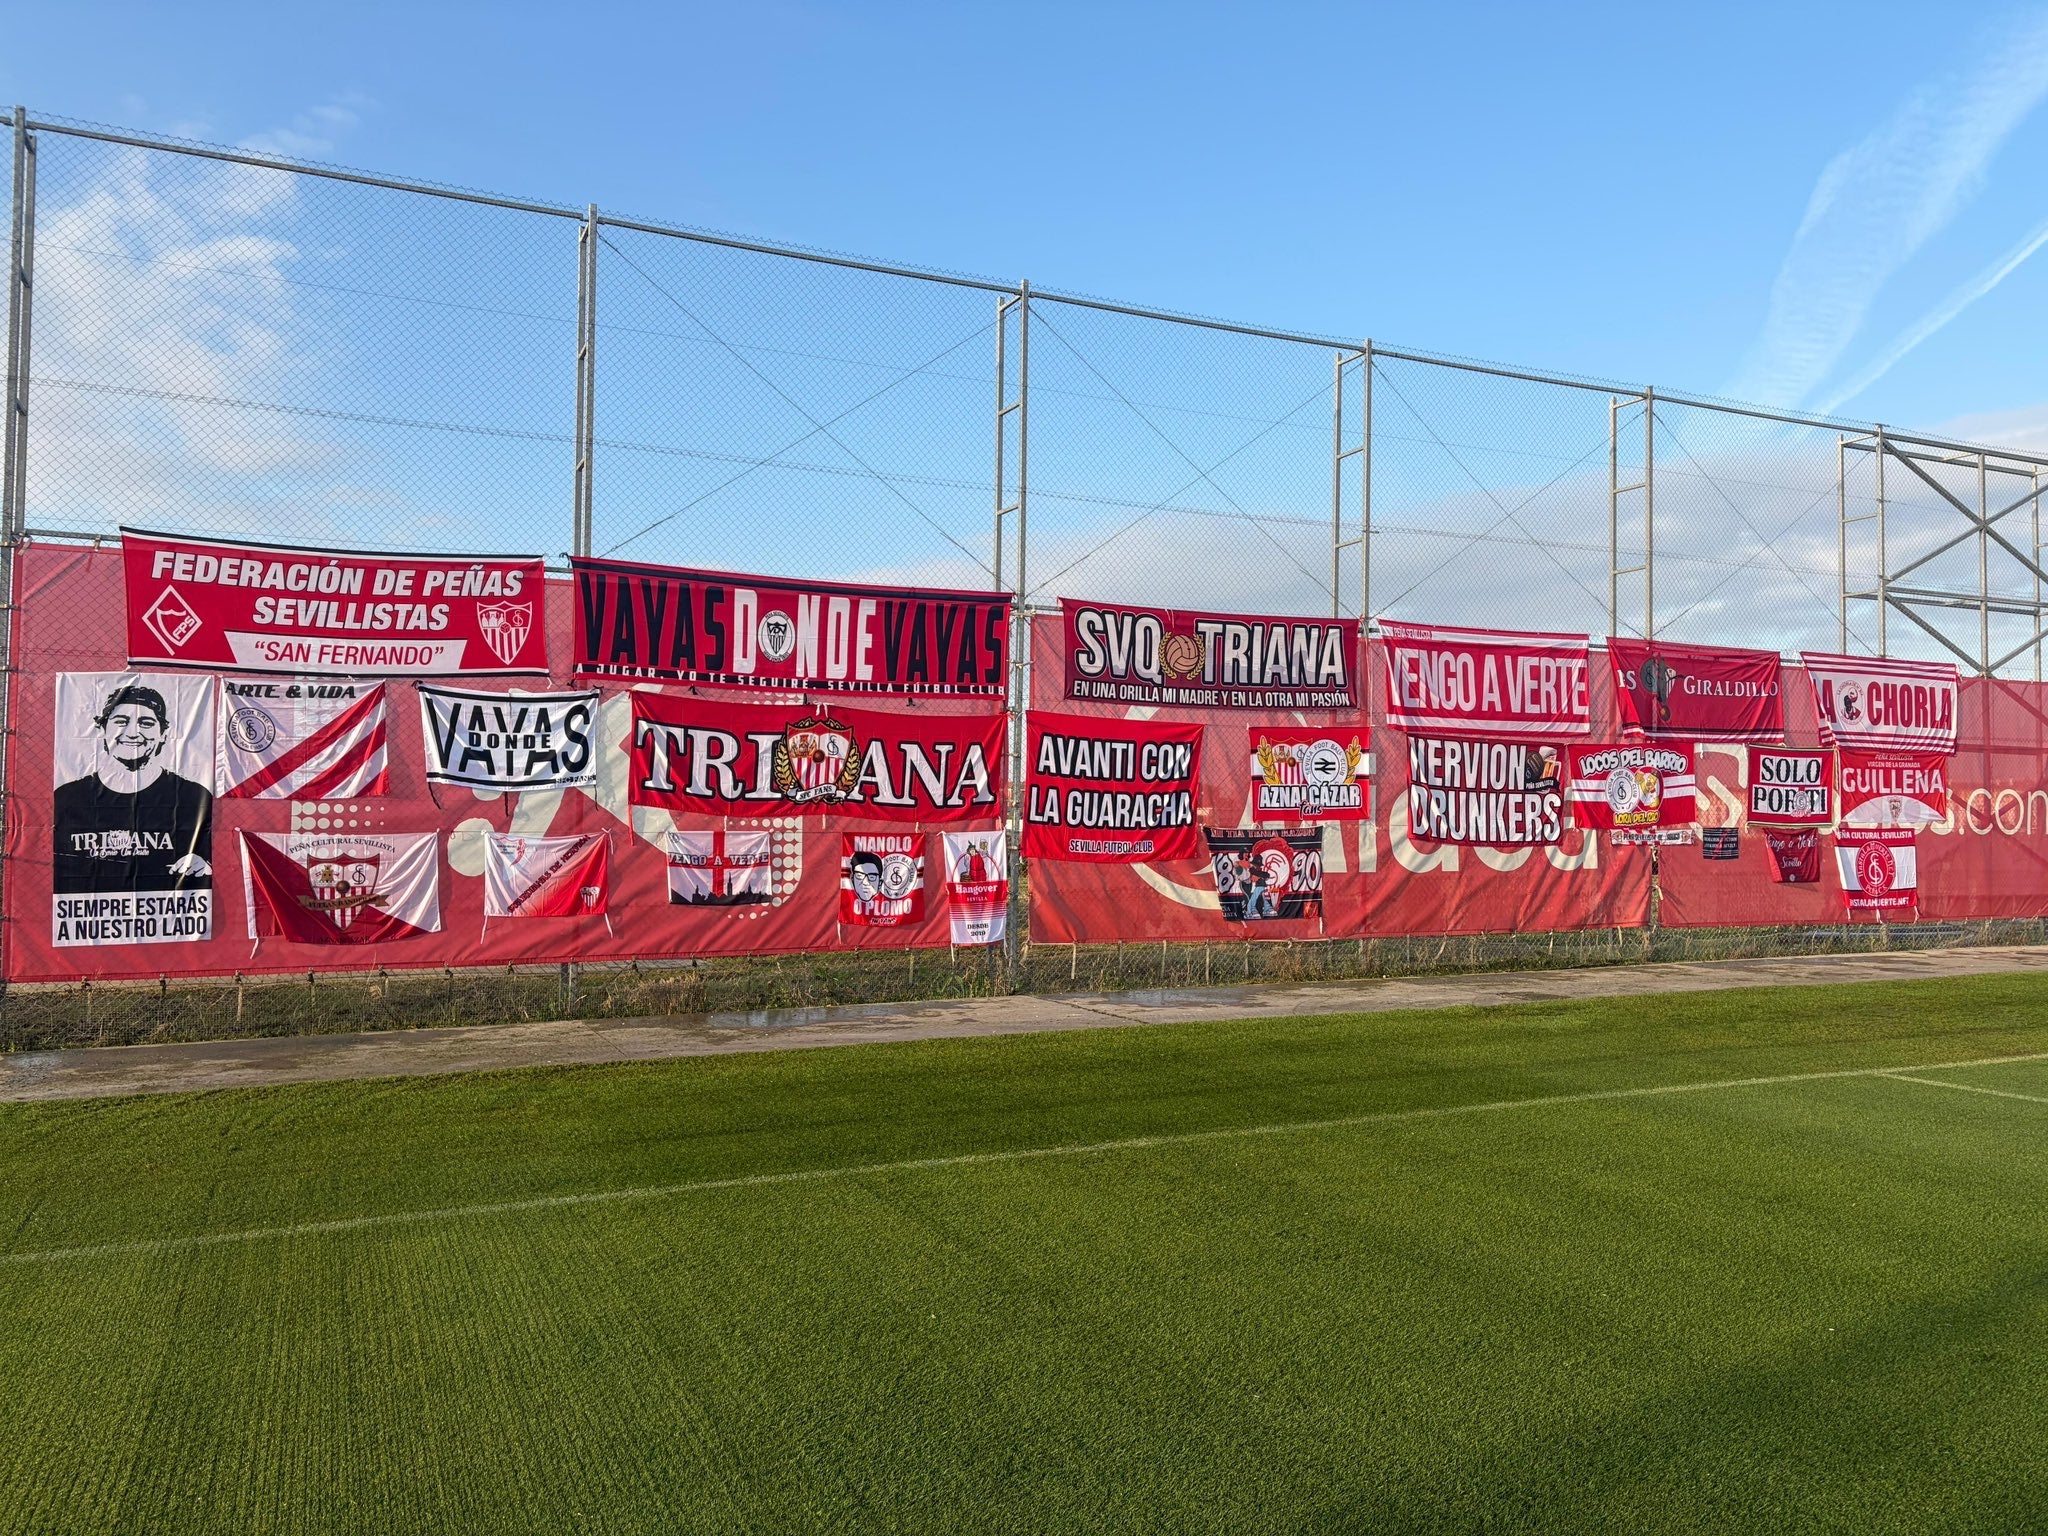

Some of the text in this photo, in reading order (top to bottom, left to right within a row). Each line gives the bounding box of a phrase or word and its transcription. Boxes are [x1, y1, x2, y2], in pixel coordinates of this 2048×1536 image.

[151, 550, 525, 597] FEDERACIÓN DE PEÑAS
[172, 615, 196, 640] FPS
[252, 596, 450, 632] SEVILLISTAS
[578, 571, 725, 672] VAYAS
[883, 599, 1004, 684] VAYAS
[1076, 608, 1348, 688] SVQ TRIANA
[225, 681, 357, 699] ARTE & VIDA
[576, 663, 584, 674] A
[677, 669, 697, 681] YO
[709, 672, 726, 684] TE
[827, 680, 894, 693] SEVILLA
[903, 681, 960, 694] FÚTBOL
[969, 684, 1005, 696] CLUB
[1384, 645, 1590, 715] VENGO A VERTE
[1073, 680, 1350, 708] EN UNA ORILLA MI MADRE Y EN LA OTRA MI PASIÓN
[1866, 680, 1952, 731] CHORLA
[425, 697, 592, 777] VAYAS
[468, 731, 551, 750] DONDE
[633, 718, 998, 809] TRIANA
[1037, 733, 1194, 782] AVANTI CON
[1305, 751, 1313, 775] SEVILLA
[1314, 742, 1328, 750] FOOT
[1408, 736, 1527, 791] NERVION
[1580, 750, 1619, 777] LOCOS
[1619, 748, 1644, 768] DEL
[1761, 757, 1821, 783] SOLO
[815, 785, 833, 796] FANS
[1842, 767, 1945, 794] GUILLENA
[1028, 784, 1193, 830] LA GUARACHA
[1259, 781, 1362, 810] AZNALCÁZAR
[1753, 786, 1826, 813] POR TI
[1410, 784, 1562, 843] DRUNKERS
[71, 830, 175, 851] TRIANA
[289, 838, 396, 854] PEÑA CULTURAL SEVILLISTA
[854, 836, 912, 852] MANOLO
[1070, 839, 1102, 853] SEVILLA
[1133, 840, 1154, 853] CLUB
[1839, 829, 1913, 840] EÑA CULTURAL SEVILLISTA
[667, 851, 770, 867] VENGO A VERTE
[1290, 851, 1323, 892] 90
[955, 883, 998, 895] Hangover
[57, 892, 208, 919] SIEMPRE ESTARÁS
[57, 915, 208, 941] A NUESTRO LADO
[967, 922, 989, 930] DESDE
